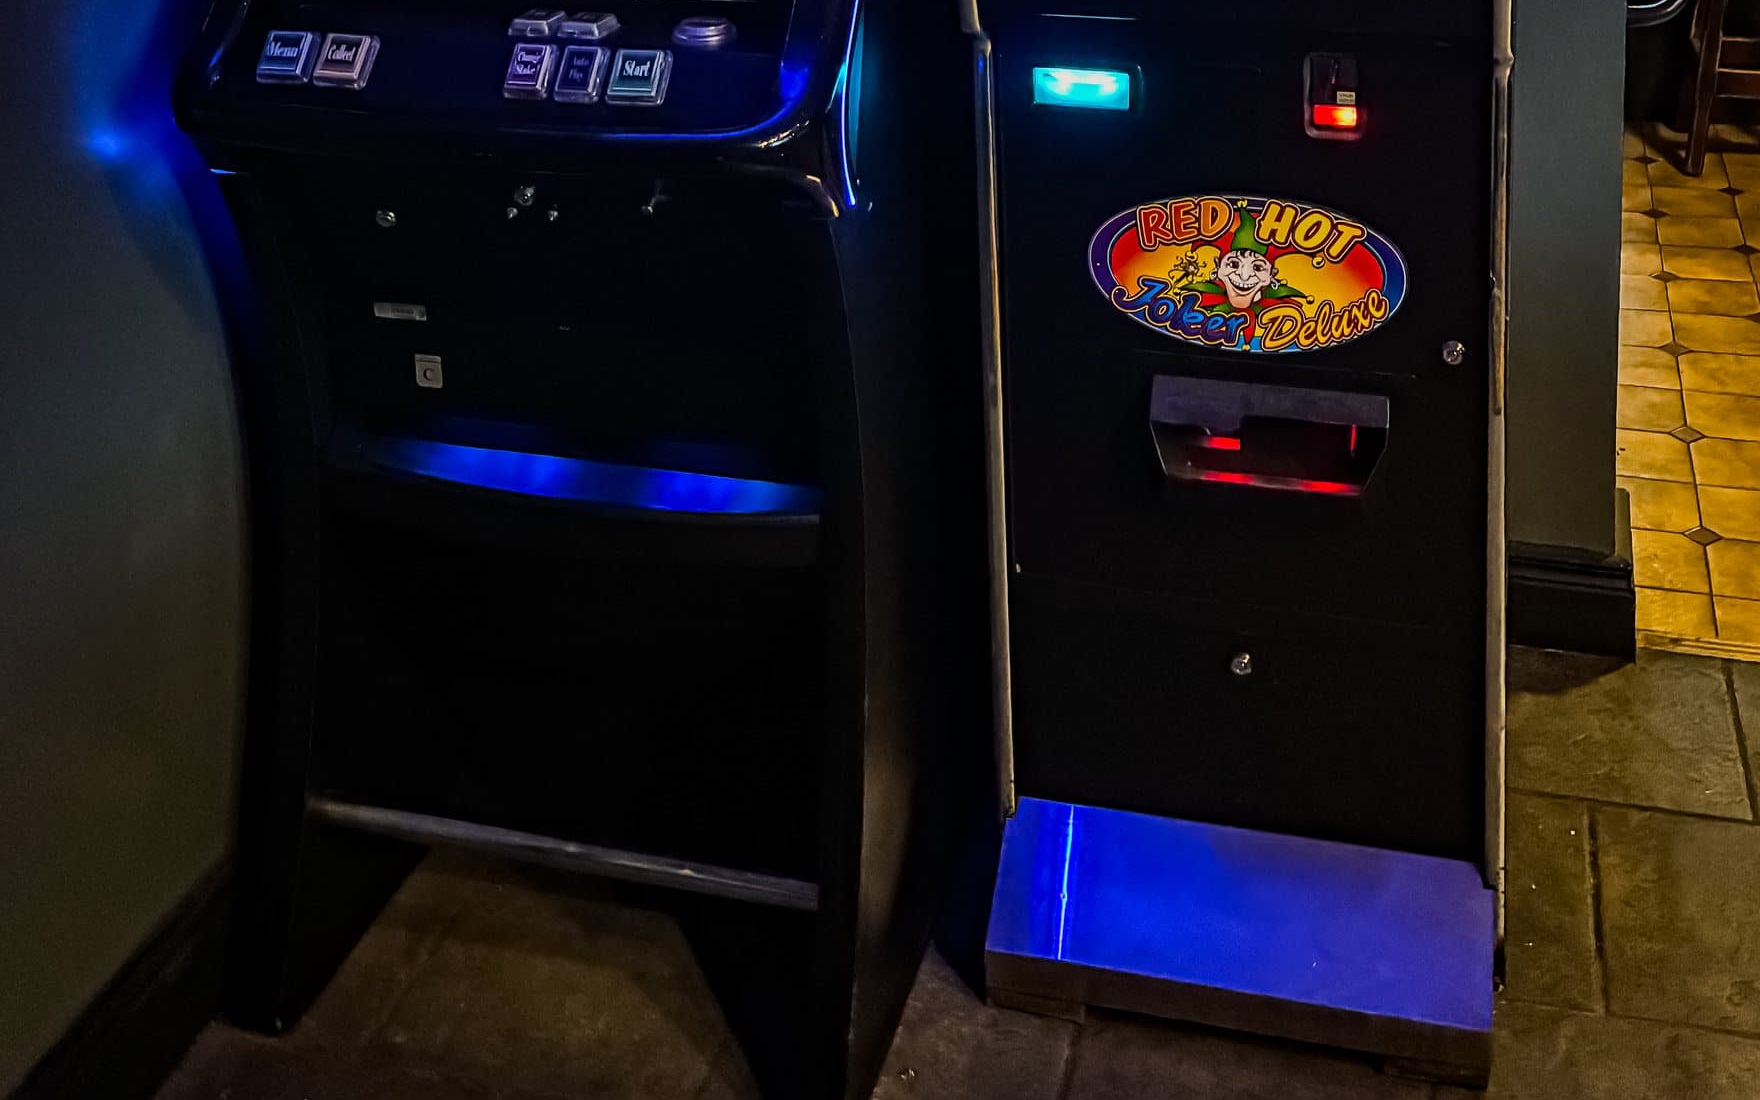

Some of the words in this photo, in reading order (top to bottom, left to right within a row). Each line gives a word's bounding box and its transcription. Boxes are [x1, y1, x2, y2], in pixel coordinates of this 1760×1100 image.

[622, 60, 651, 77] Start
[1137, 196, 1233, 251] RED
[1256, 200, 1367, 261] HOT
[1111, 276, 1249, 346] Joker
[1257, 290, 1389, 350] Deluxe
